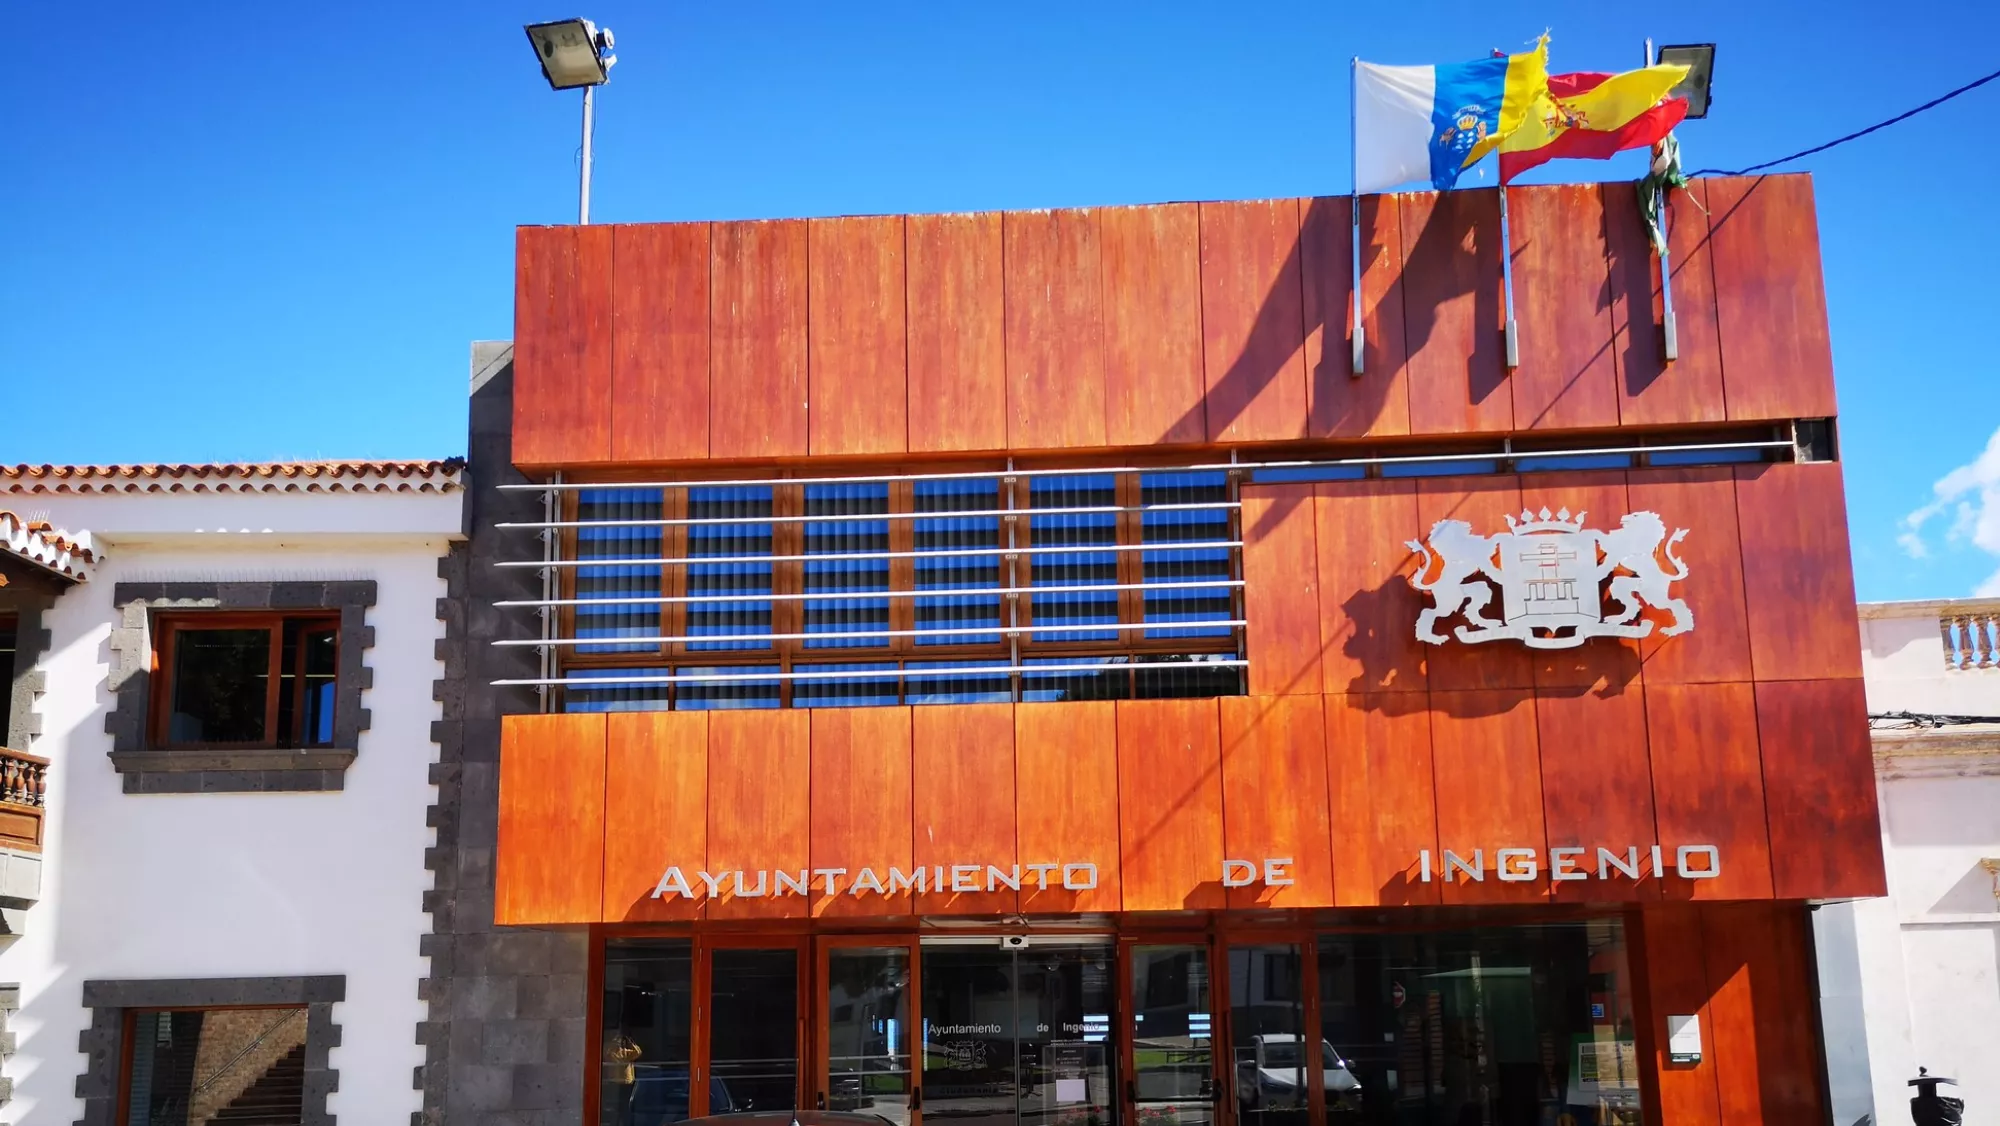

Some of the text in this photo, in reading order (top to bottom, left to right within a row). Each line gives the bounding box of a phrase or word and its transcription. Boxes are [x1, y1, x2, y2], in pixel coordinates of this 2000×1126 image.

[650, 844, 1721, 899] AYUNTAMIENTO DE INGENIO
[927, 1021, 1100, 1036] Ayuntamiento de Ingenio
